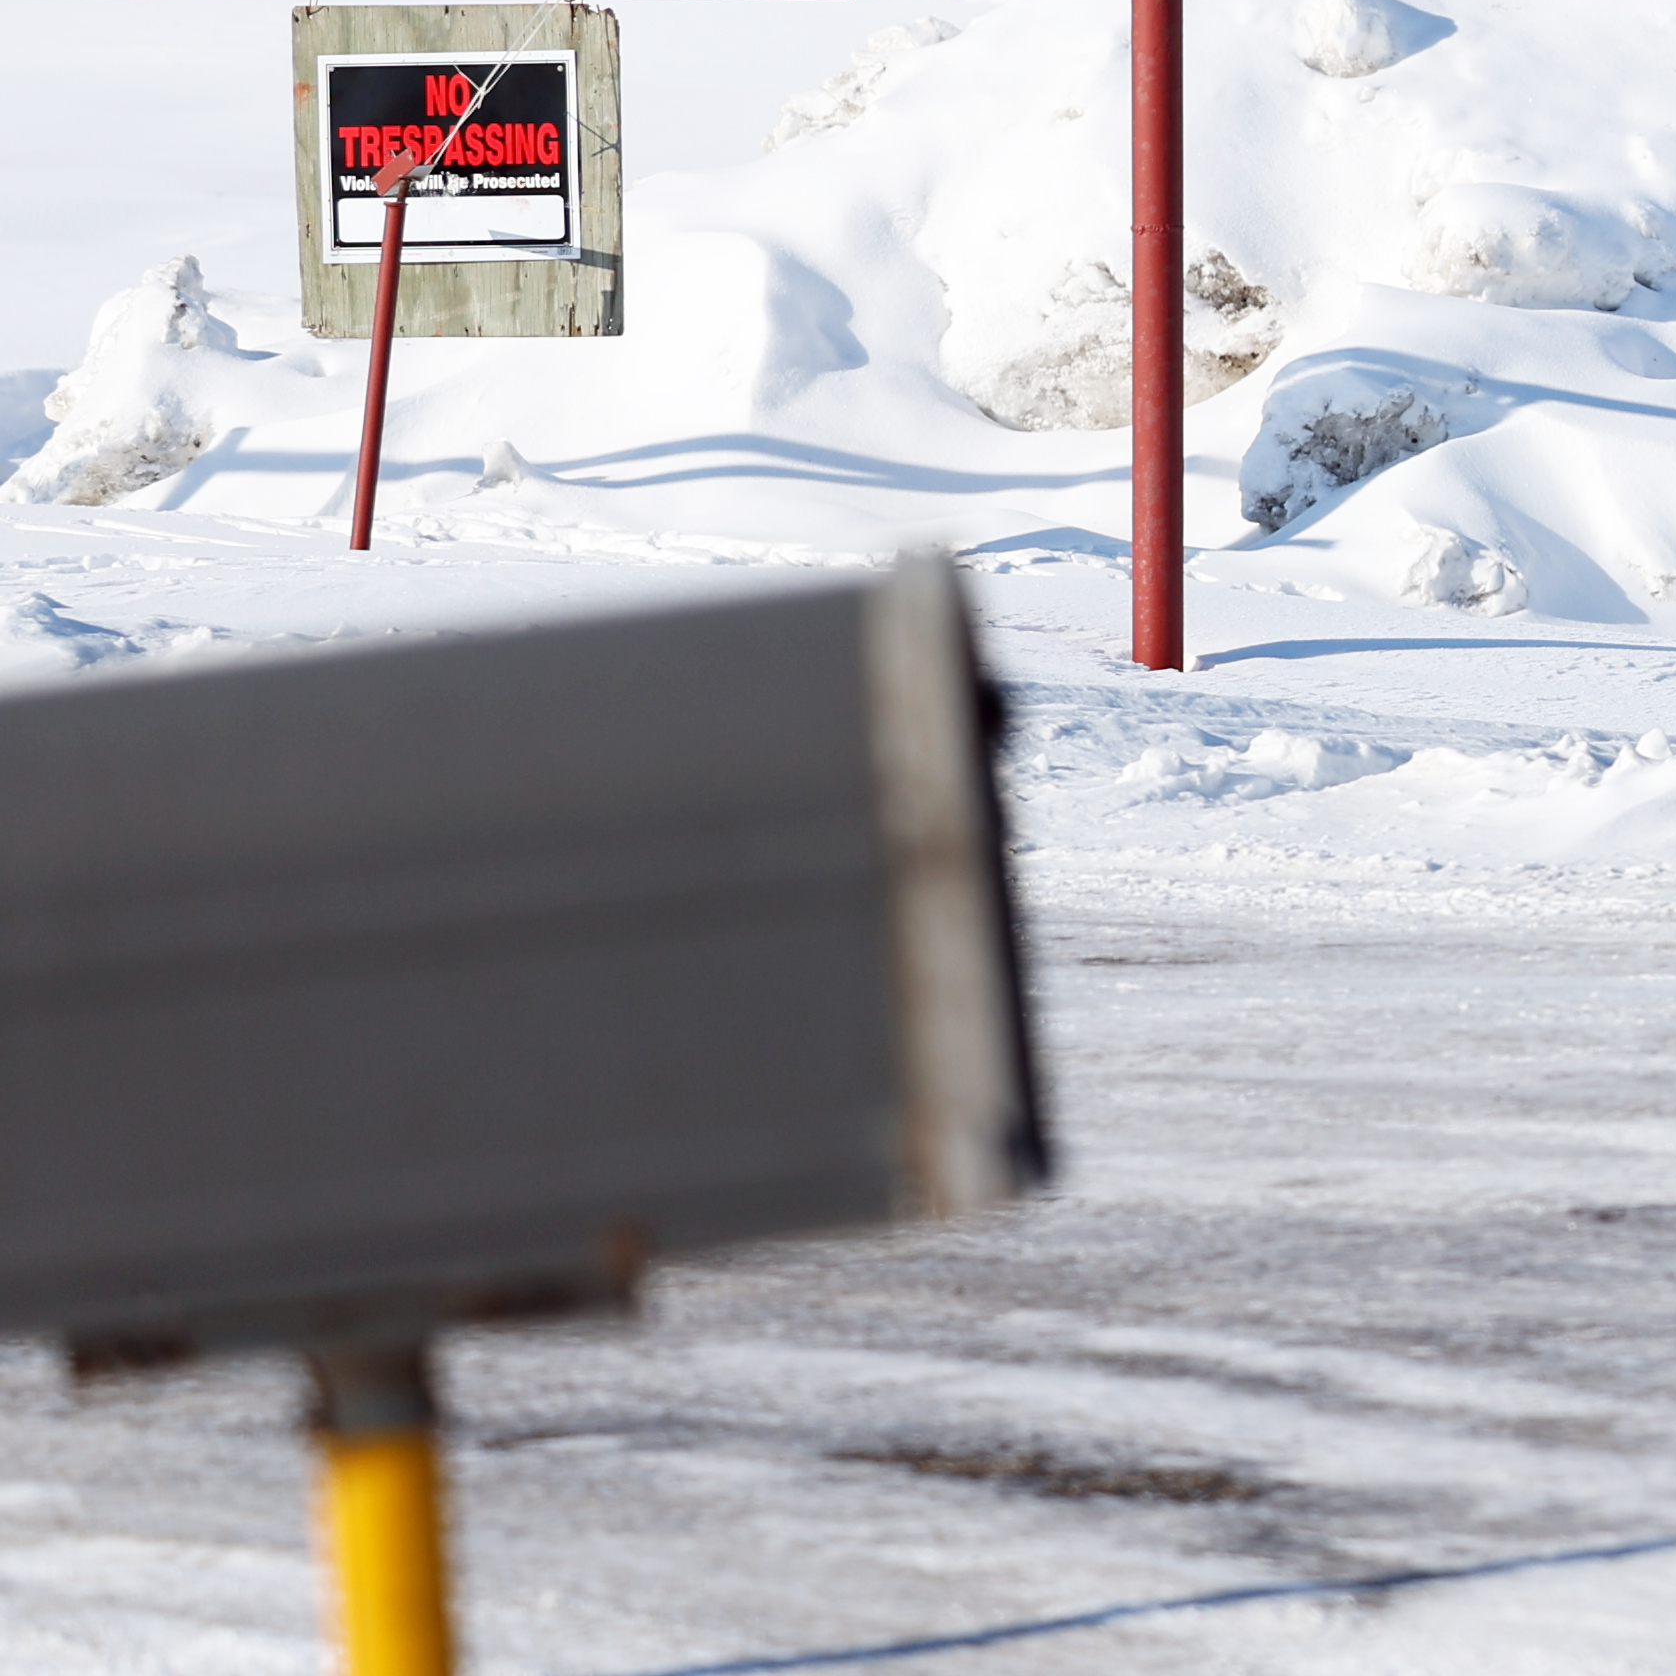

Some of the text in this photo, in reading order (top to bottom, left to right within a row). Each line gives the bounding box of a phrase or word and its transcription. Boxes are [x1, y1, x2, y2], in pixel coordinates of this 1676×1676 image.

[425, 73, 471, 116] NO
[338, 122, 561, 168] TRESPASSING
[472, 173, 560, 190] Prosecuted
